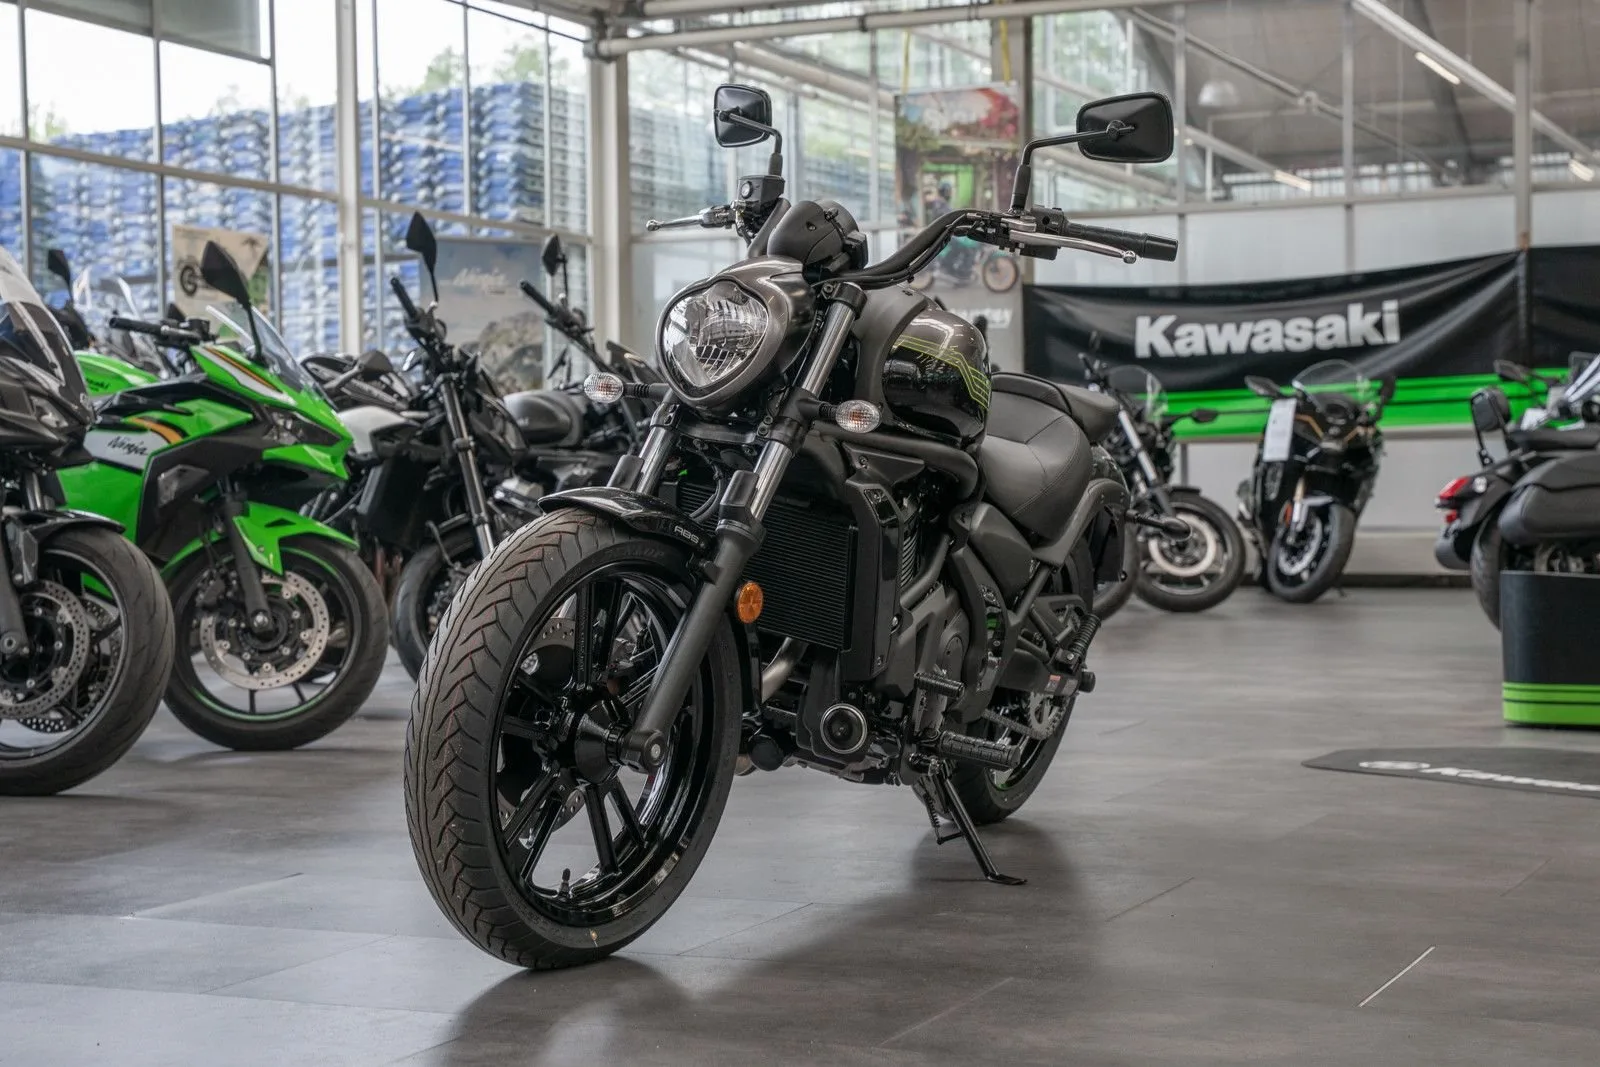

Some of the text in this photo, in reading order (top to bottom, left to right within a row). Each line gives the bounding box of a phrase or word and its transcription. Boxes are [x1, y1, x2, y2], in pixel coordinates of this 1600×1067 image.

[1134, 300, 1400, 359] Kawasaki
[107, 436, 149, 456] Ninja
[673, 525, 700, 545] ABS
